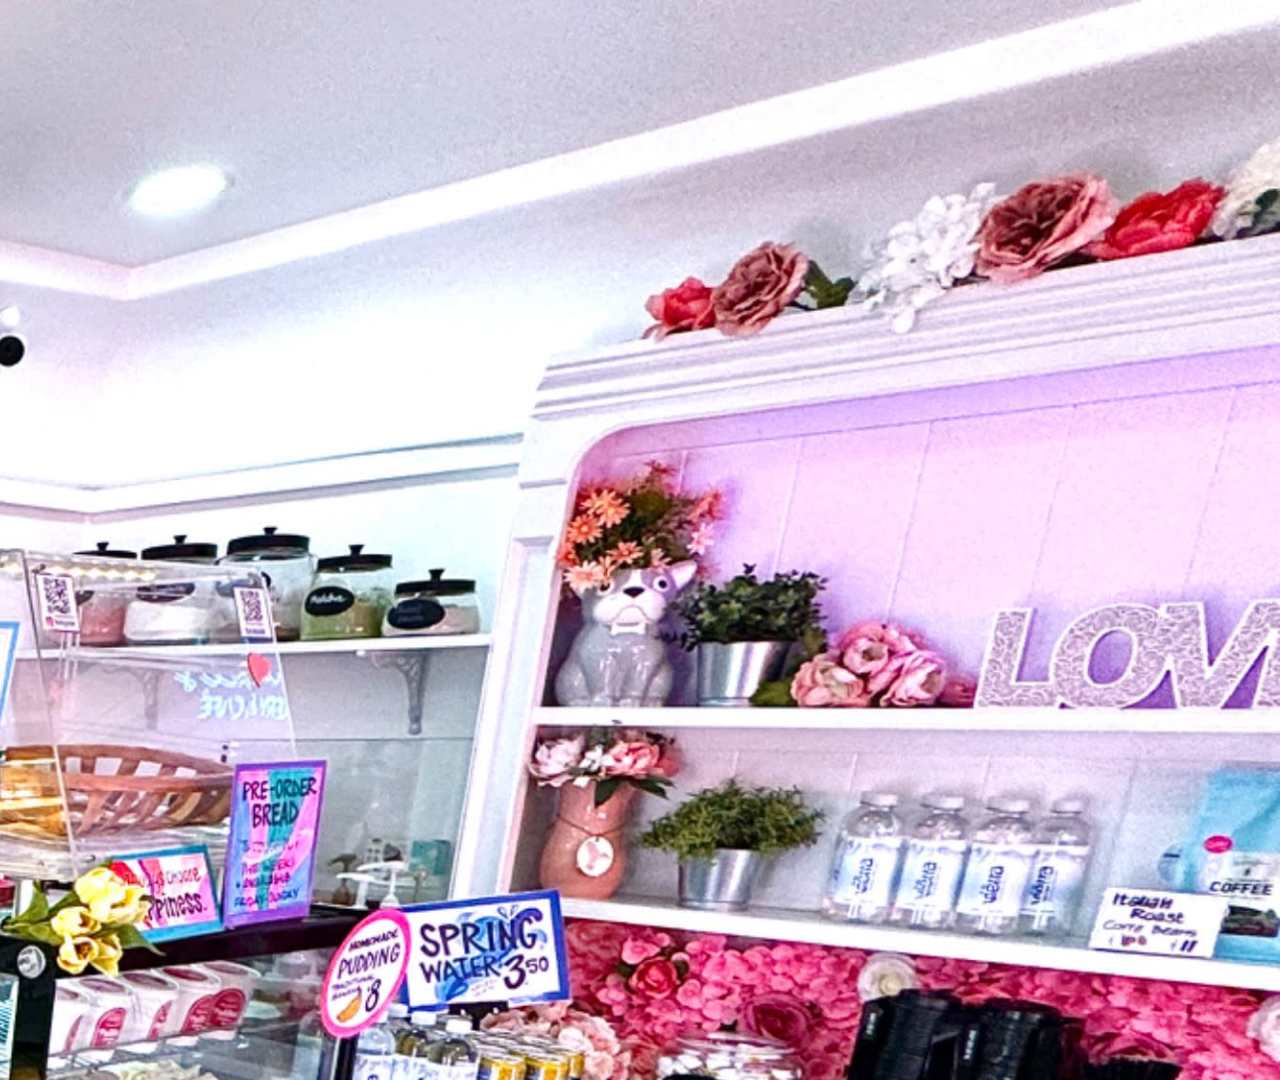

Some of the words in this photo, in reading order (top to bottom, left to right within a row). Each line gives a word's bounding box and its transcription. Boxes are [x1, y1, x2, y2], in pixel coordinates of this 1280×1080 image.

[243, 777, 317, 801] PRE-ORDER
[253, 801, 299, 828] BREAD
[1210, 881, 1273, 895] COFFEE
[420, 908, 543, 957] SPRING
[338, 944, 401, 980] PUDDING
[419, 954, 501, 984] WATER
